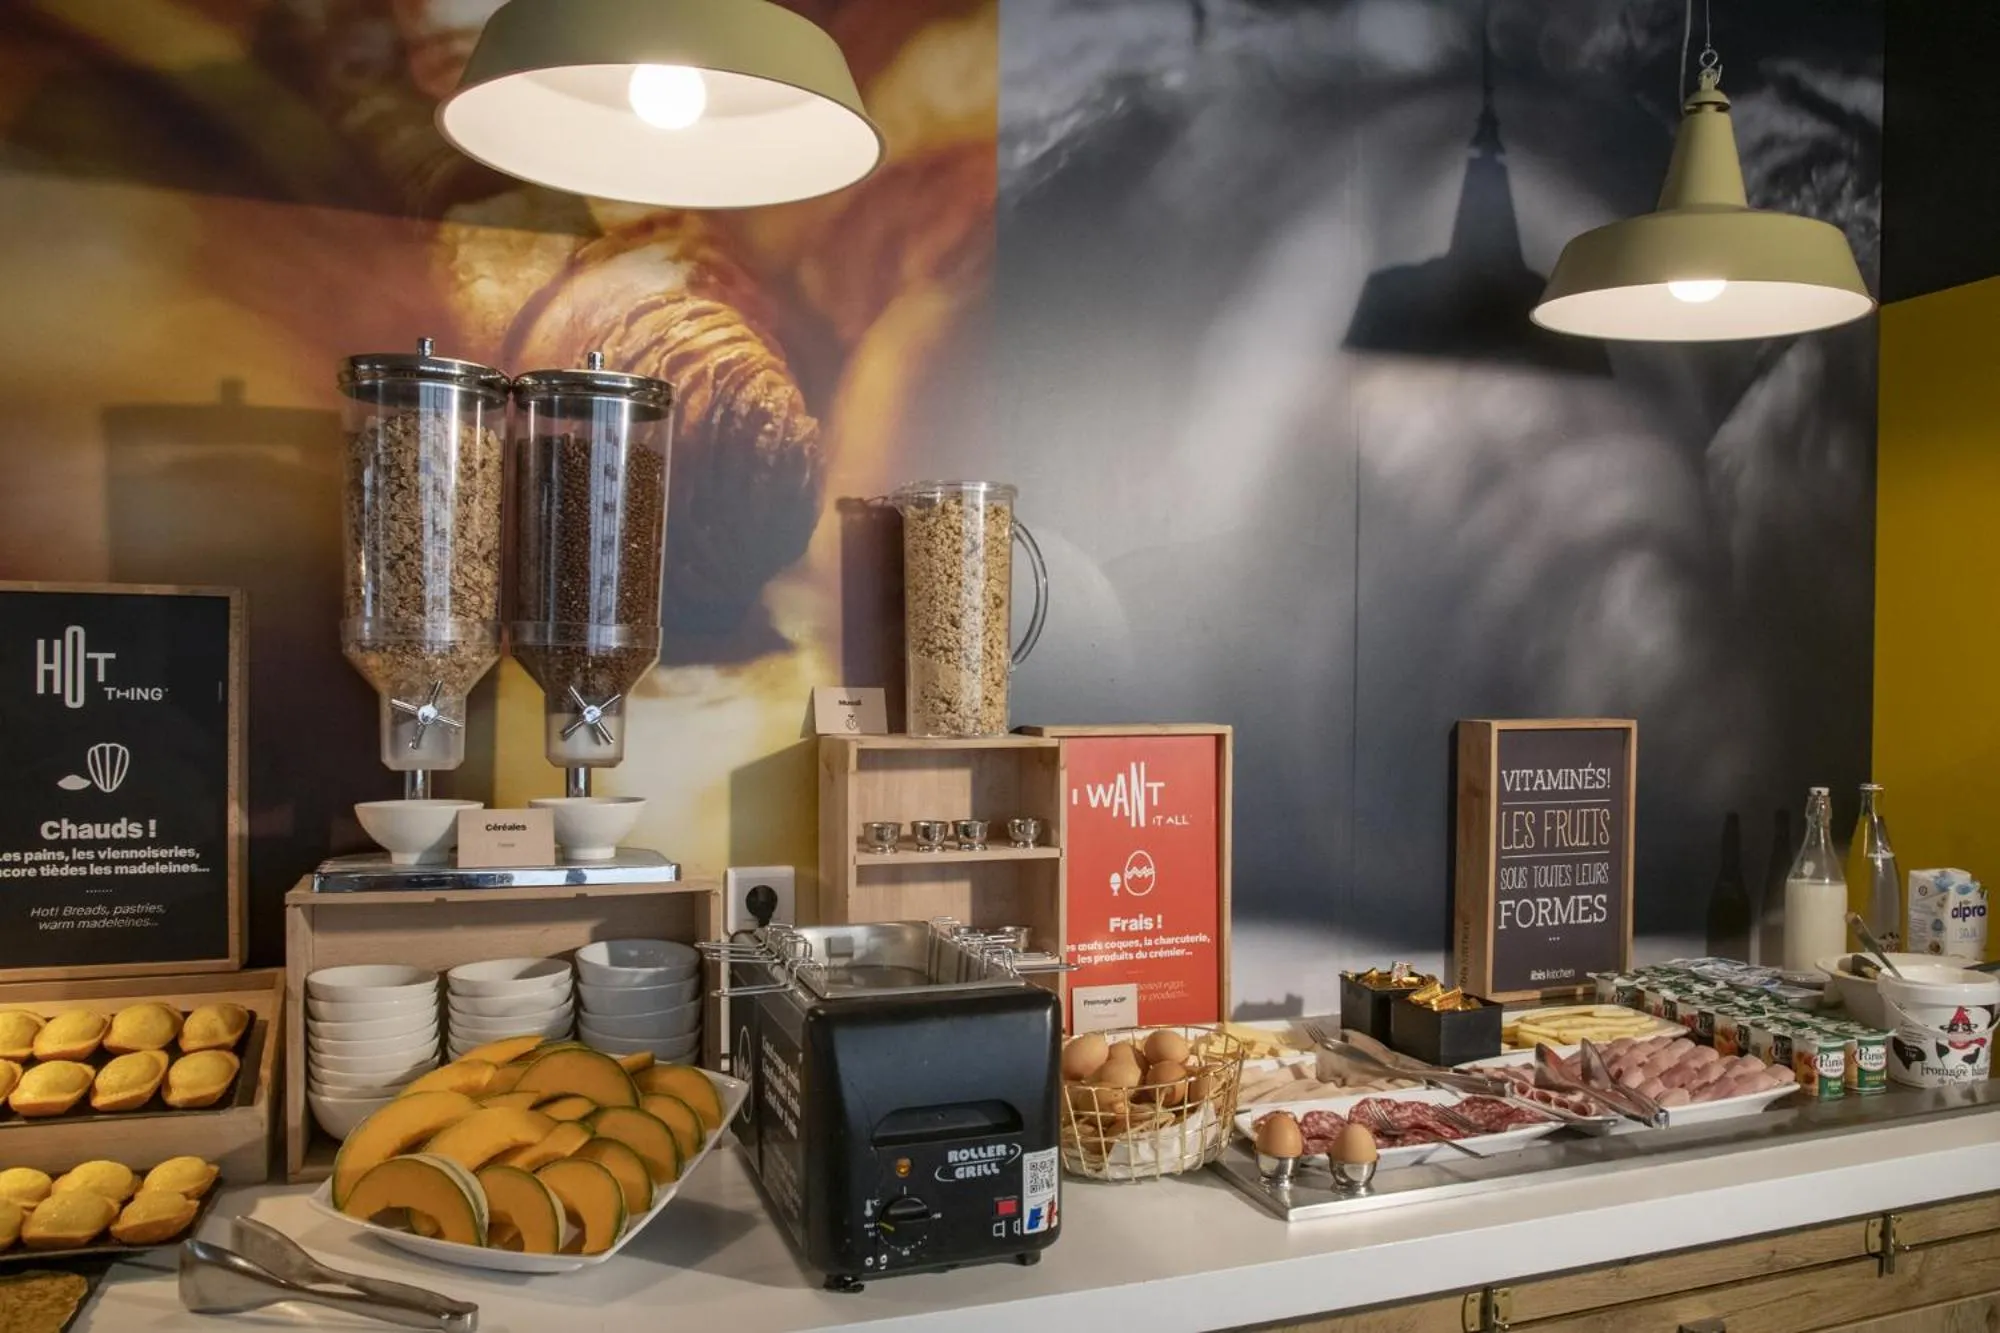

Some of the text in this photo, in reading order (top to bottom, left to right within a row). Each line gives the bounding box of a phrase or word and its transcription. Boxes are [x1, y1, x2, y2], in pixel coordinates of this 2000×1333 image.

[36, 625, 116, 709] HOT
[104, 687, 164, 701] THING
[1502, 762, 1611, 792] VITAMINÉS!
[1087, 761, 1165, 827] WANT
[40, 818, 144, 840] Chauds
[1165, 814, 1189, 825] ALL
[1502, 808, 1610, 850] LES FRUITS
[0, 845, 200, 864] es pains, les viennoiseries,
[40, 863, 87, 877] tièdes
[90, 862, 112, 876] les
[1500, 862, 1609, 890] SOUS TOUTES LEURS
[1498, 894, 1608, 930] FORMES
[1951, 901, 1986, 923] alpro
[38, 918, 75, 931] warm
[1109, 914, 1154, 932] Frais
[1154, 932, 1211, 946] charcuterie,
[1094, 949, 1134, 965] produits
[1135, 949, 1148, 960] du
[947, 1144, 1007, 1164] ROLLER
[954, 1162, 1000, 1180] GRILL
